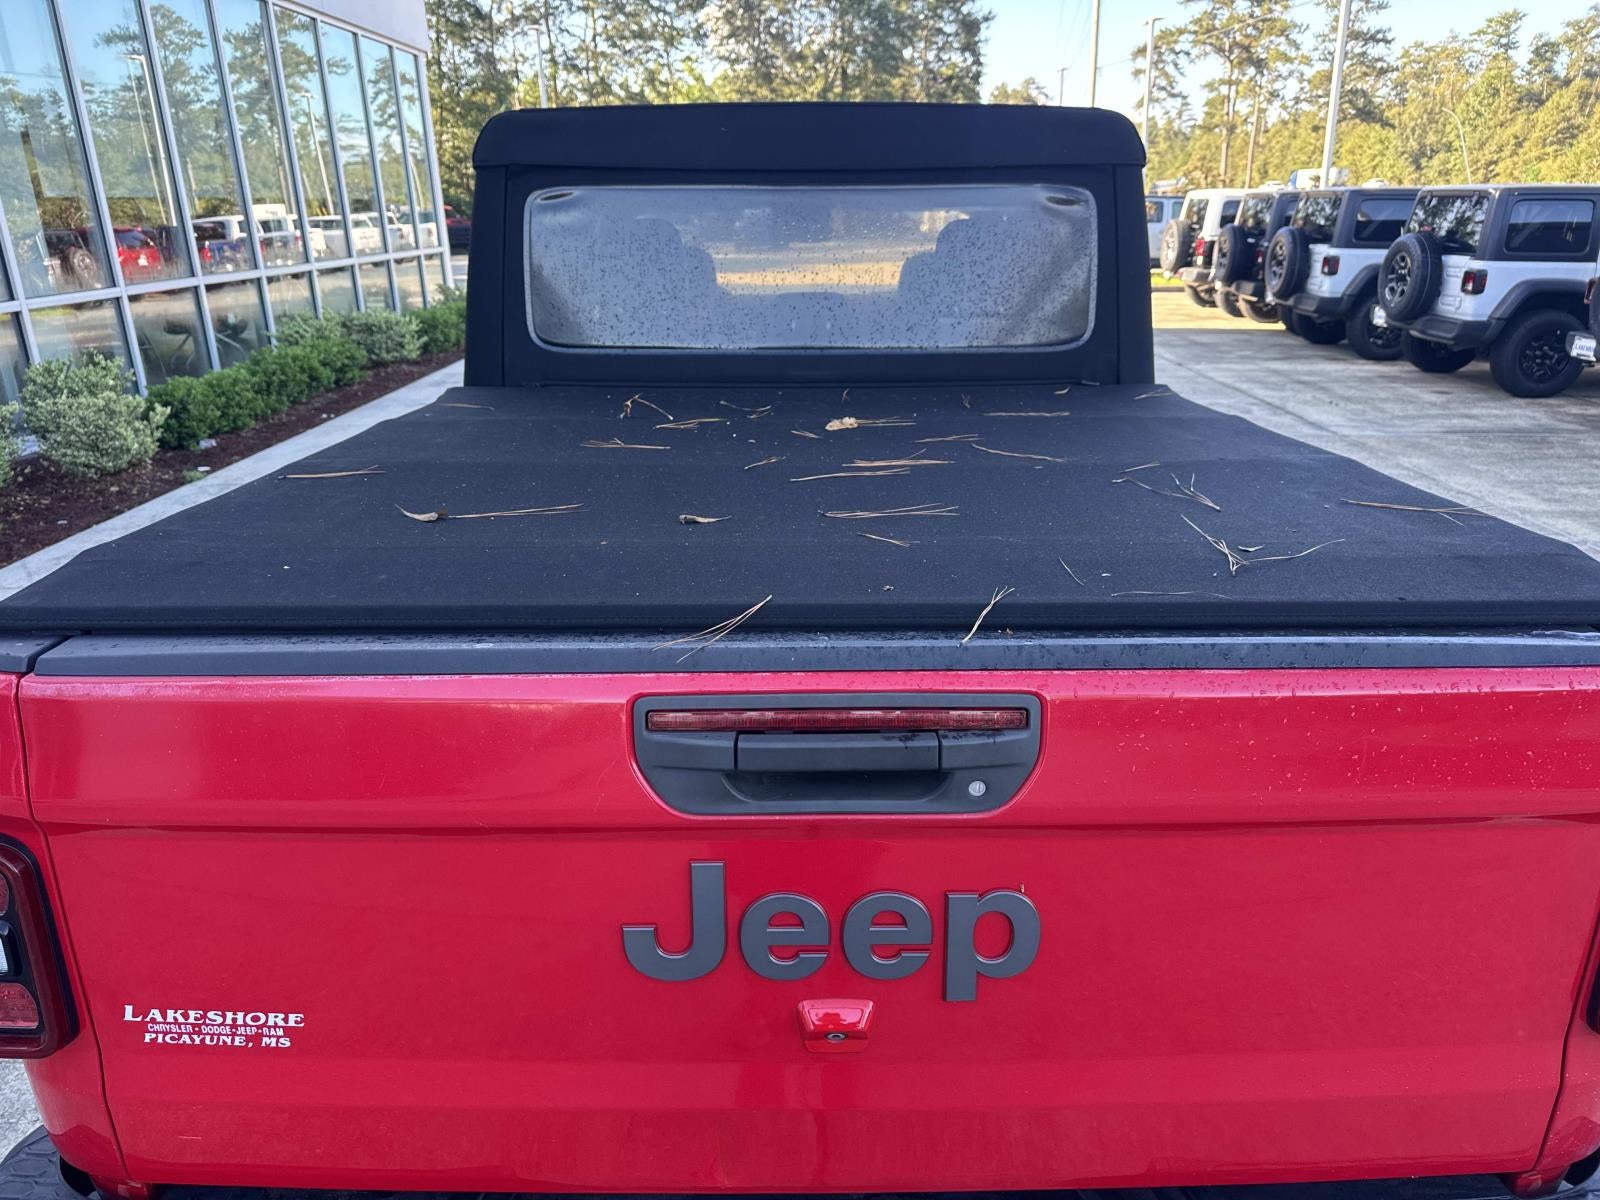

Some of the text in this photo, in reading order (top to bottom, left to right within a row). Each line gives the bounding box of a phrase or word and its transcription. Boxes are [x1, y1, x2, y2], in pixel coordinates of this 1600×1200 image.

[622, 860, 1041, 1001] Jeep
[123, 1004, 305, 1027] LAKESHORE
[144, 1033, 291, 1048] PICAYUNE, MS
